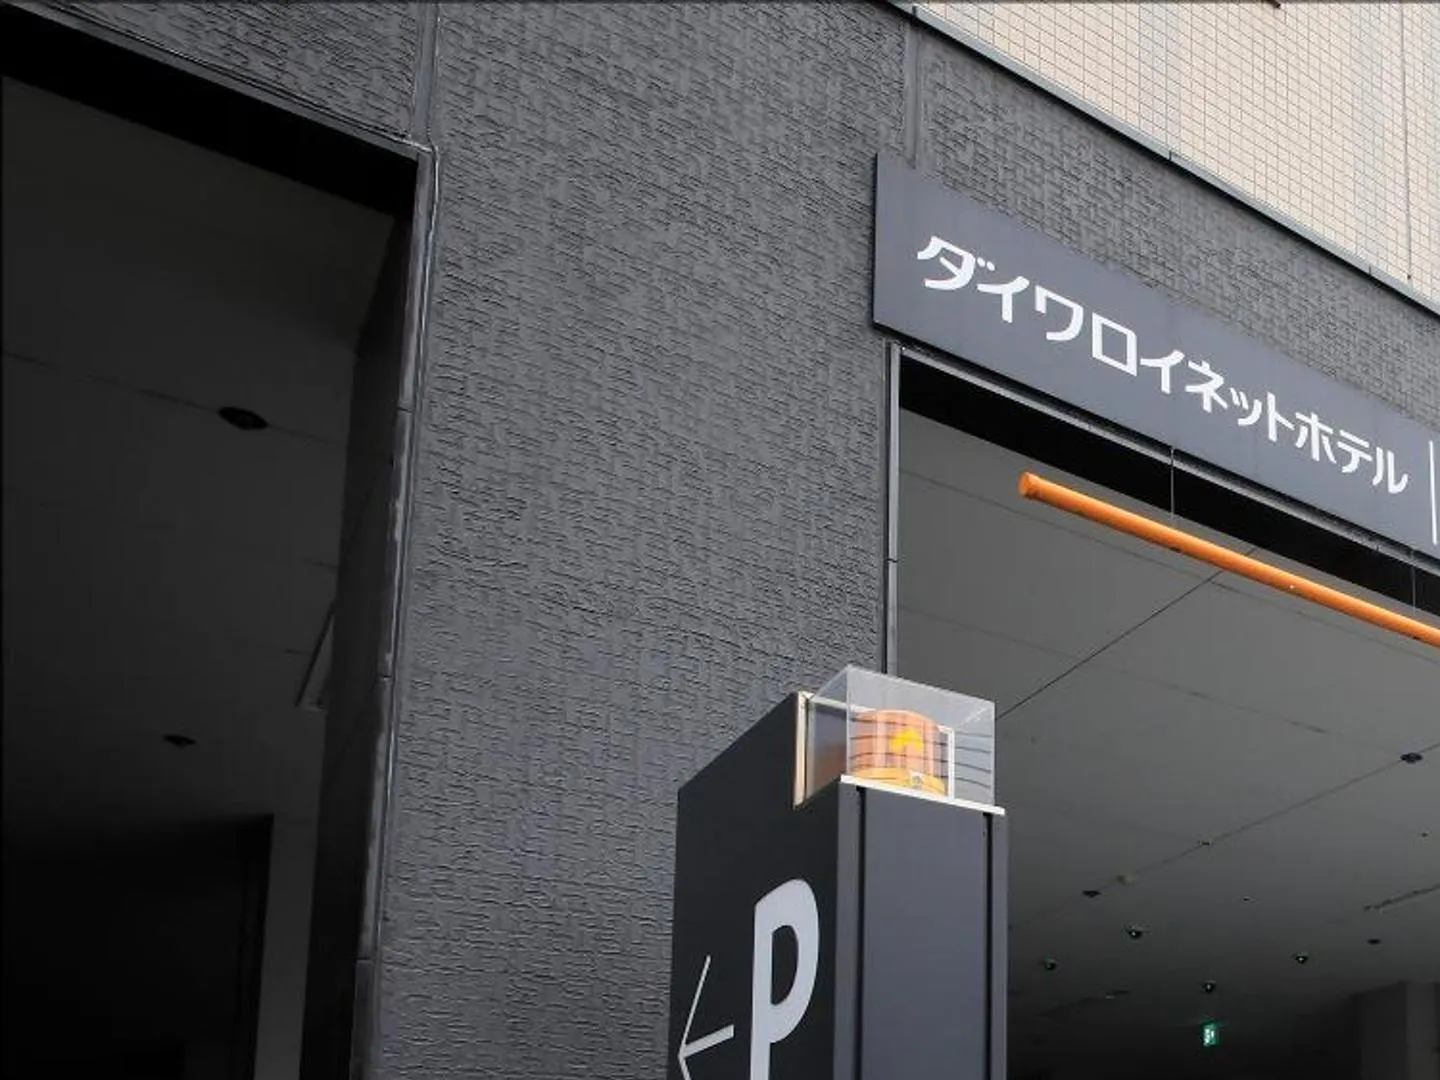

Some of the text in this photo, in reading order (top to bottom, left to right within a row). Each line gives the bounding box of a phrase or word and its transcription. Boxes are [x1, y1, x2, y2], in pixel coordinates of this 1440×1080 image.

[917, 235, 1409, 494] ダイワロイネットホテル
